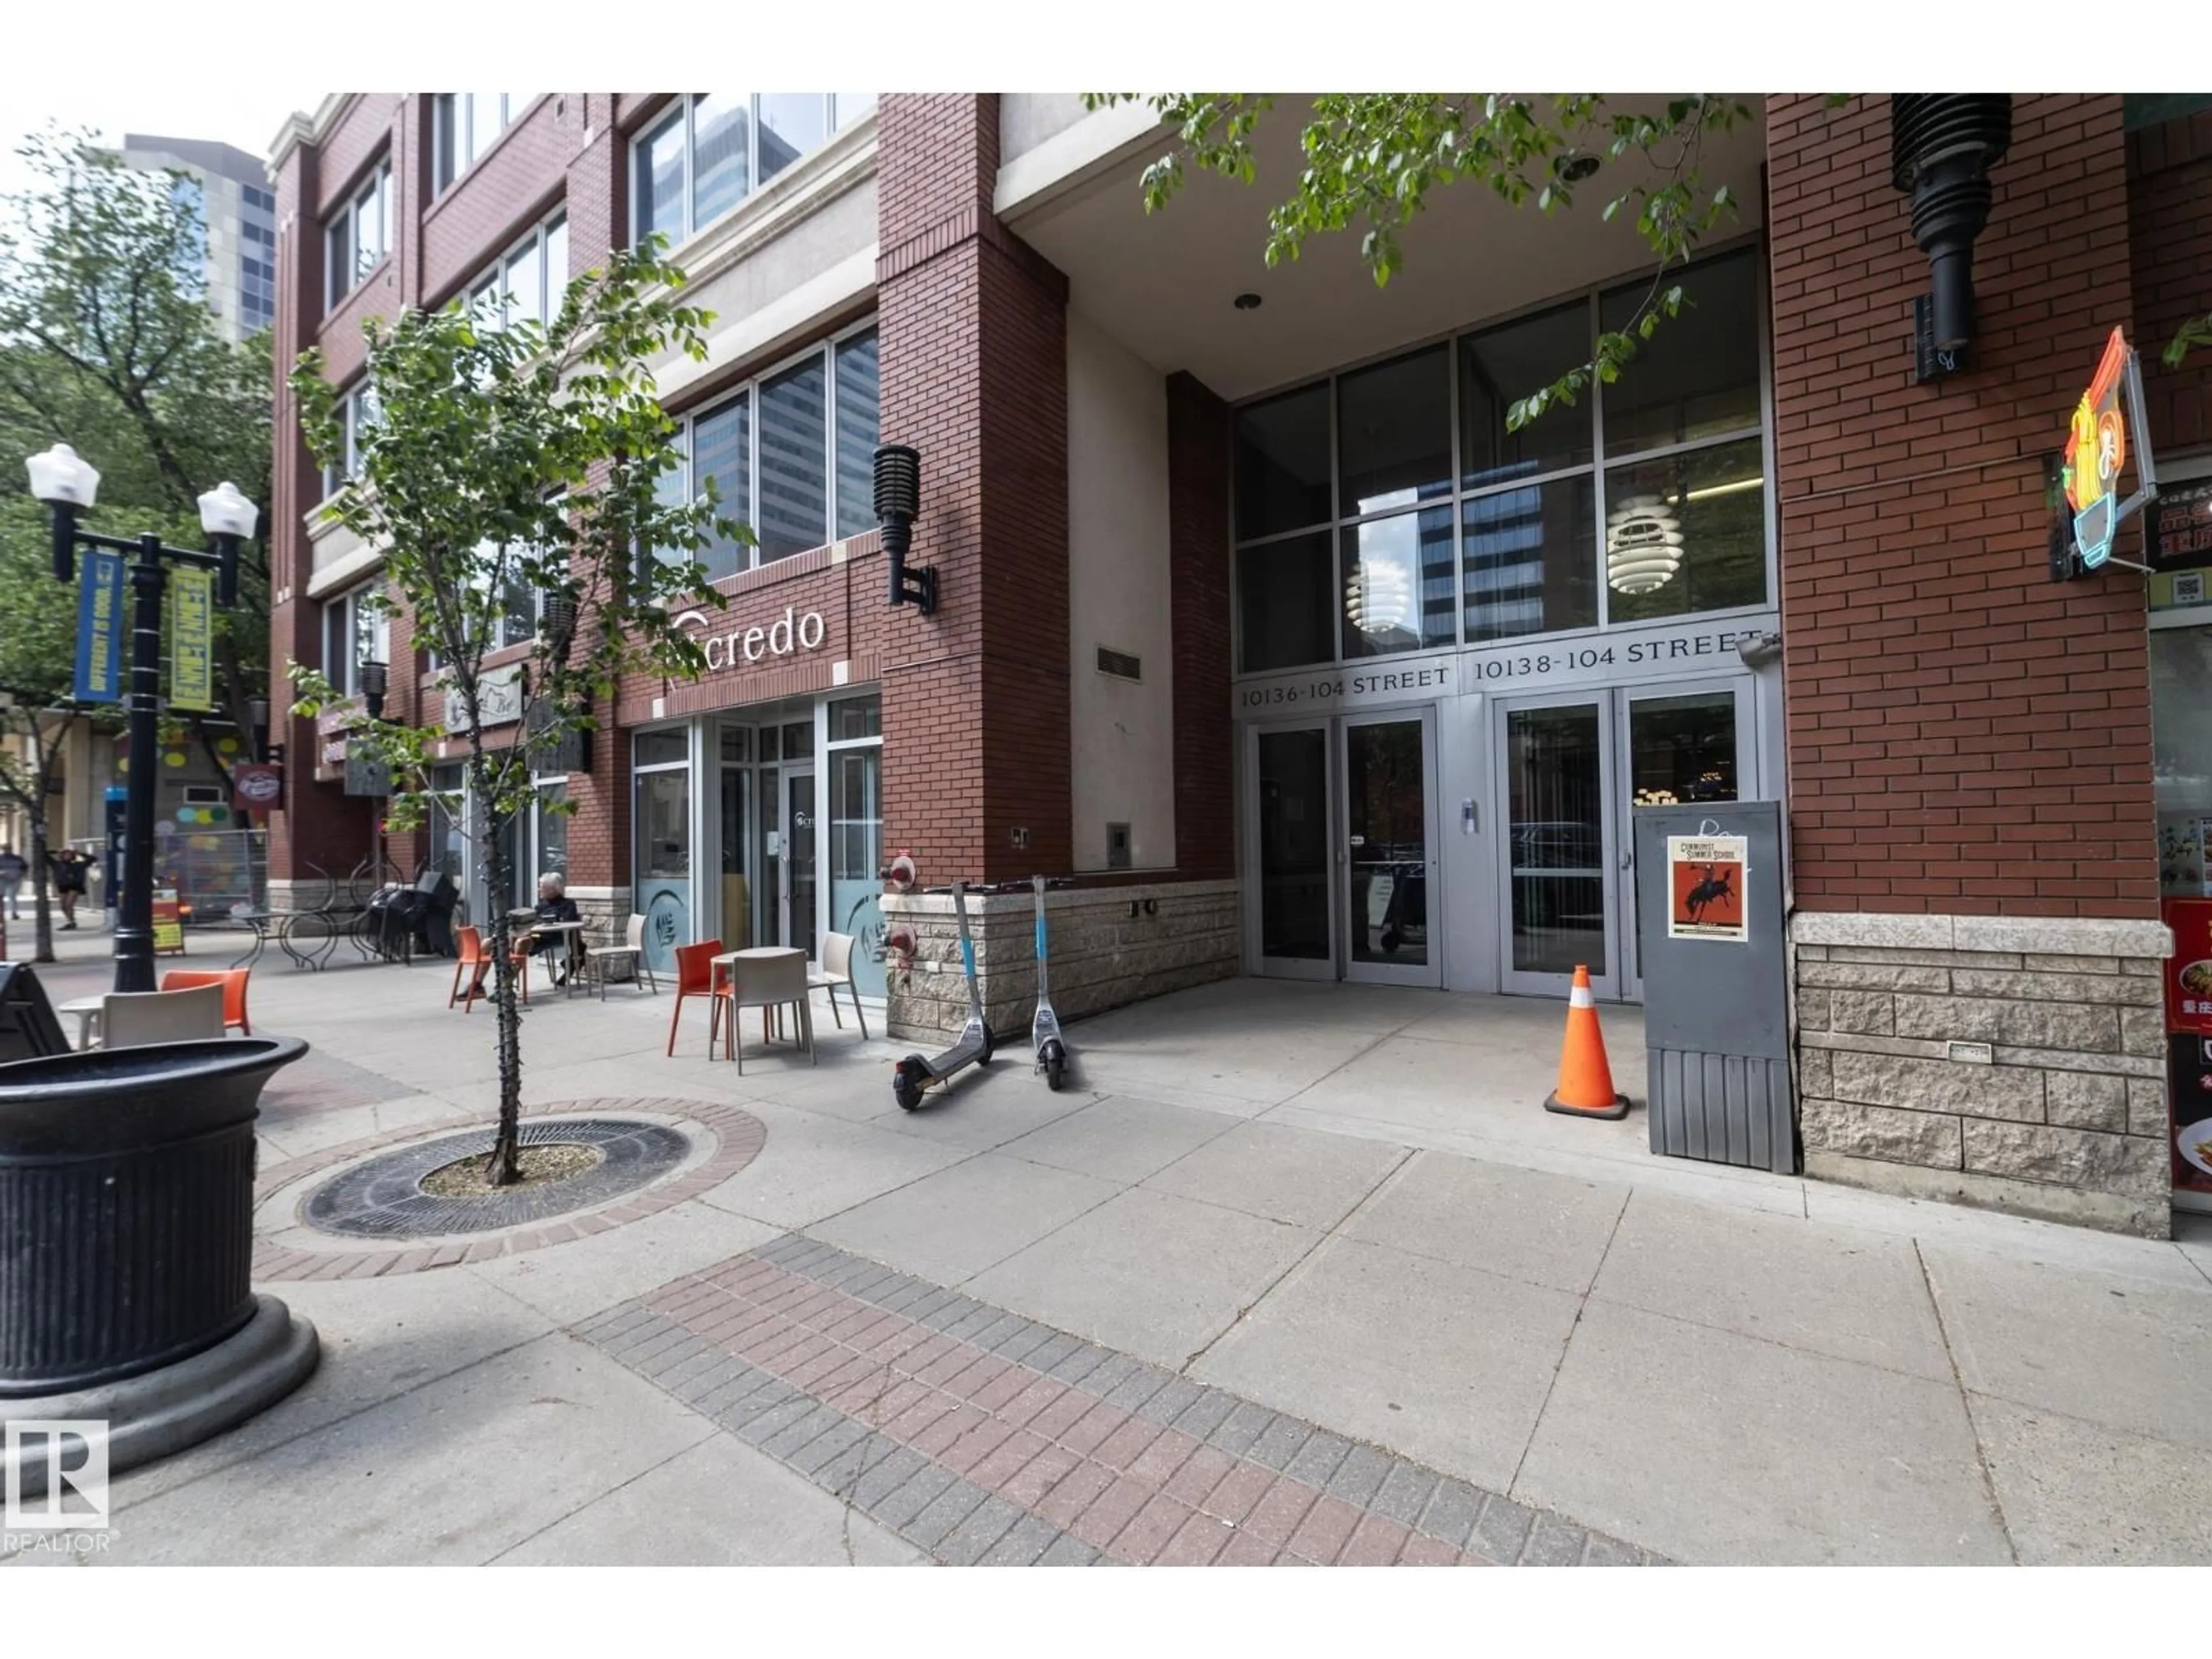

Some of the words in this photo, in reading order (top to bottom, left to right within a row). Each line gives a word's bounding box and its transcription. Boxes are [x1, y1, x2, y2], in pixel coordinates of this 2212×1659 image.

[92, 619, 110, 631] IS
[704, 607, 824, 671] credo
[89, 632, 109, 692] DIFFERENT
[1475, 647, 1615, 680] 10138-104
[1241, 680, 1345, 707] 10136-104
[1353, 668, 1449, 694] STREET
